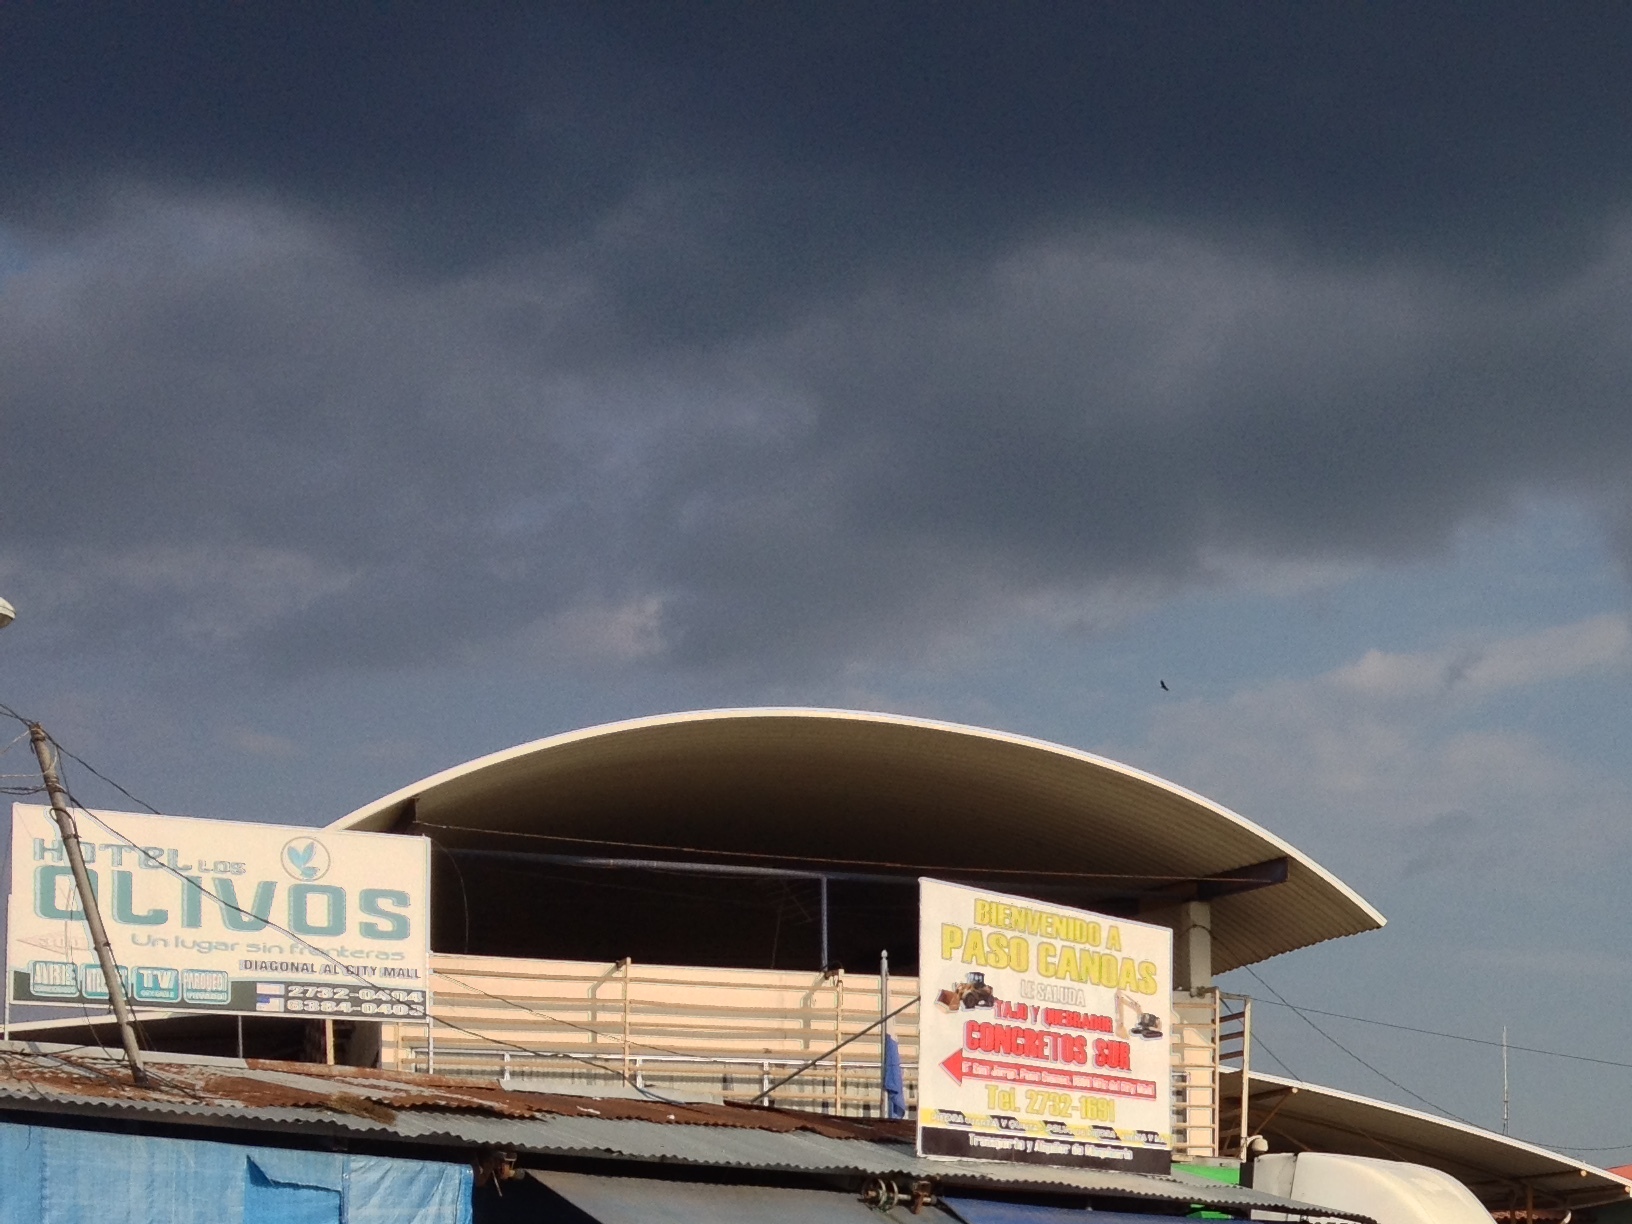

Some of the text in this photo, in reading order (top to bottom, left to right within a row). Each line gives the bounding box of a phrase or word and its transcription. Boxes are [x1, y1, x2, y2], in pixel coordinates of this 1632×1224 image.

[33, 838, 247, 876] HOTEL LOS
[34, 864, 412, 941] OLIVOS
[974, 898, 1122, 951] BIENVENIDO A
[131, 933, 407, 962] Un lugar sin fronteras
[941, 922, 1158, 995] PASO CANOAS
[139, 969, 175, 989] TV
[241, 960, 421, 980] DIAGONAL AL CITY MALL
[1036, 982, 1086, 1007] SALUDA
[994, 999, 1028, 1021] TAJO
[963, 1020, 1132, 1072] CONCRETOS SUR
[986, 1084, 1021, 1113] Tel.
